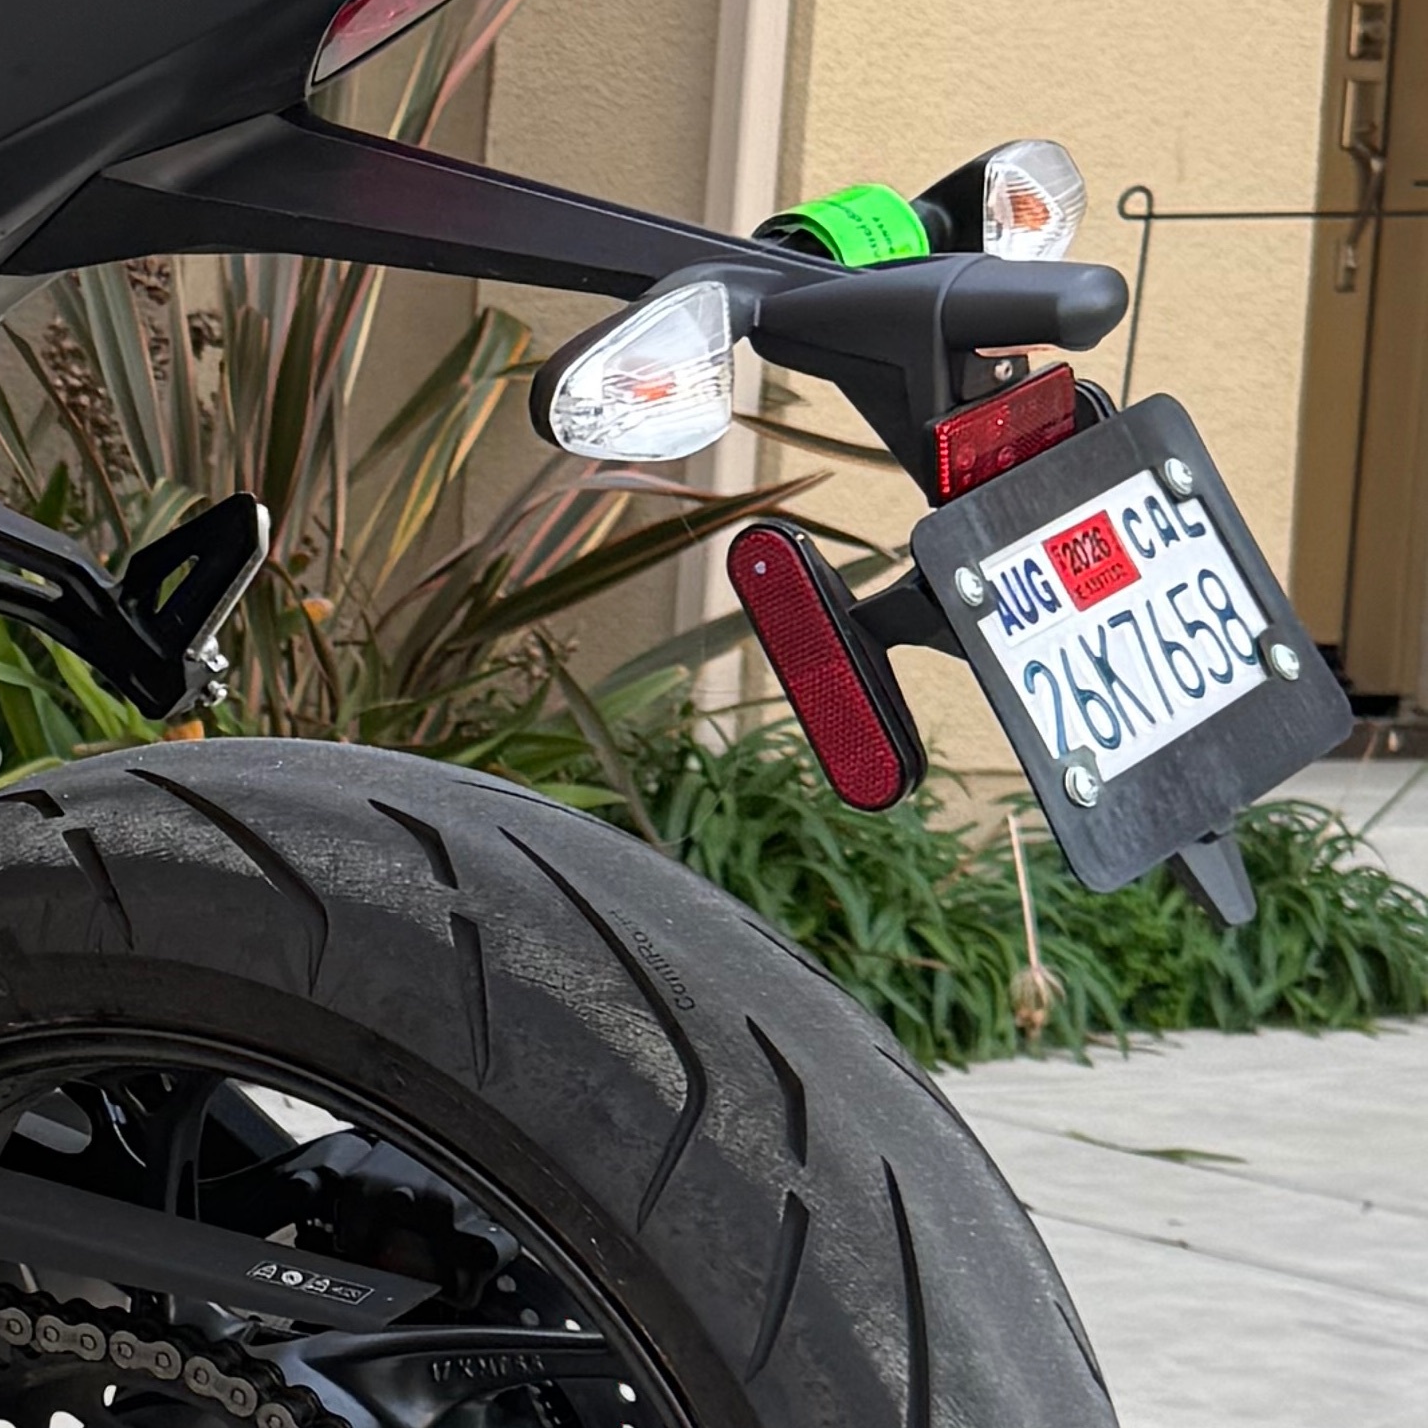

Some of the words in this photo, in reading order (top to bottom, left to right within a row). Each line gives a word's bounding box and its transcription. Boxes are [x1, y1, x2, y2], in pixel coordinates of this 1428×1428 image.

[996, 557, 1062, 636] AUG
[1061, 526, 1112, 576] 2026
[1122, 495, 1206, 560] CAL
[1024, 569, 1259, 755] 26K7658
